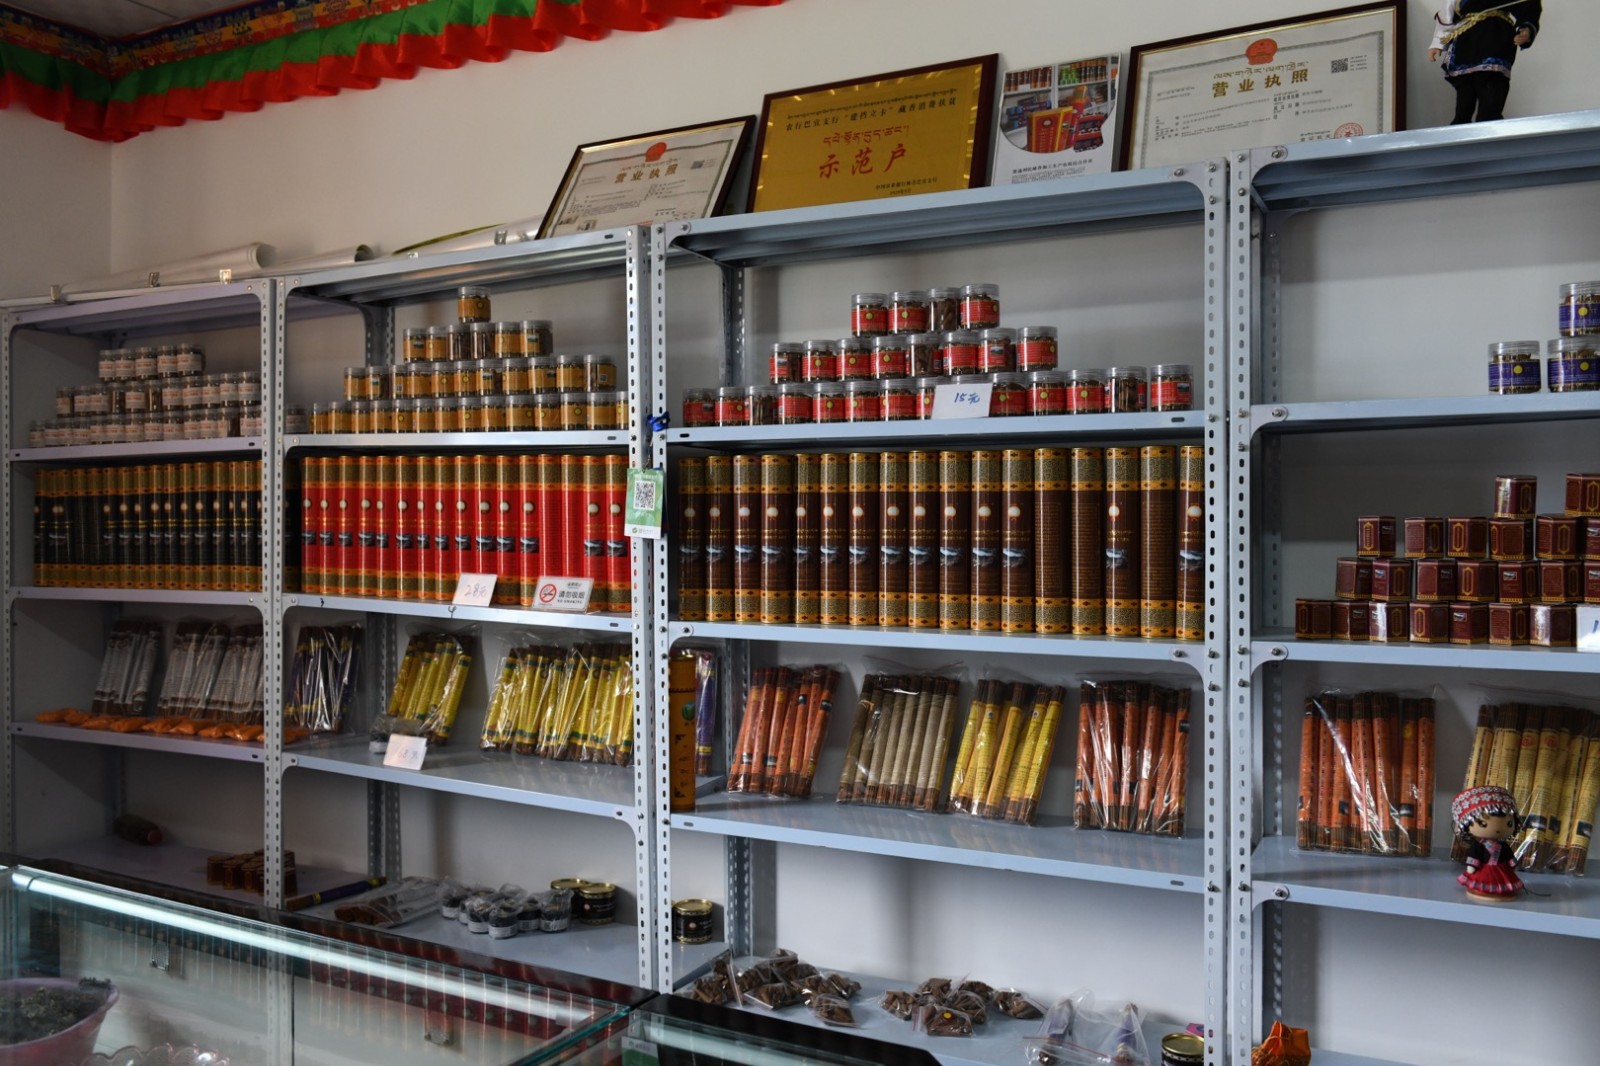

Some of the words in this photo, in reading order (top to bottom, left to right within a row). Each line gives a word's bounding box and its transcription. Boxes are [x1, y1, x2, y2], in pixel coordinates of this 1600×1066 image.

[1212, 69, 1308, 98] 营业执照
[819, 143, 906, 178] 示范户
[614, 163, 679, 184] 营业执照
[954, 392, 980, 405] 15元
[464, 583, 488, 598] 28元
[559, 590, 586, 599] 请勿吸烟
